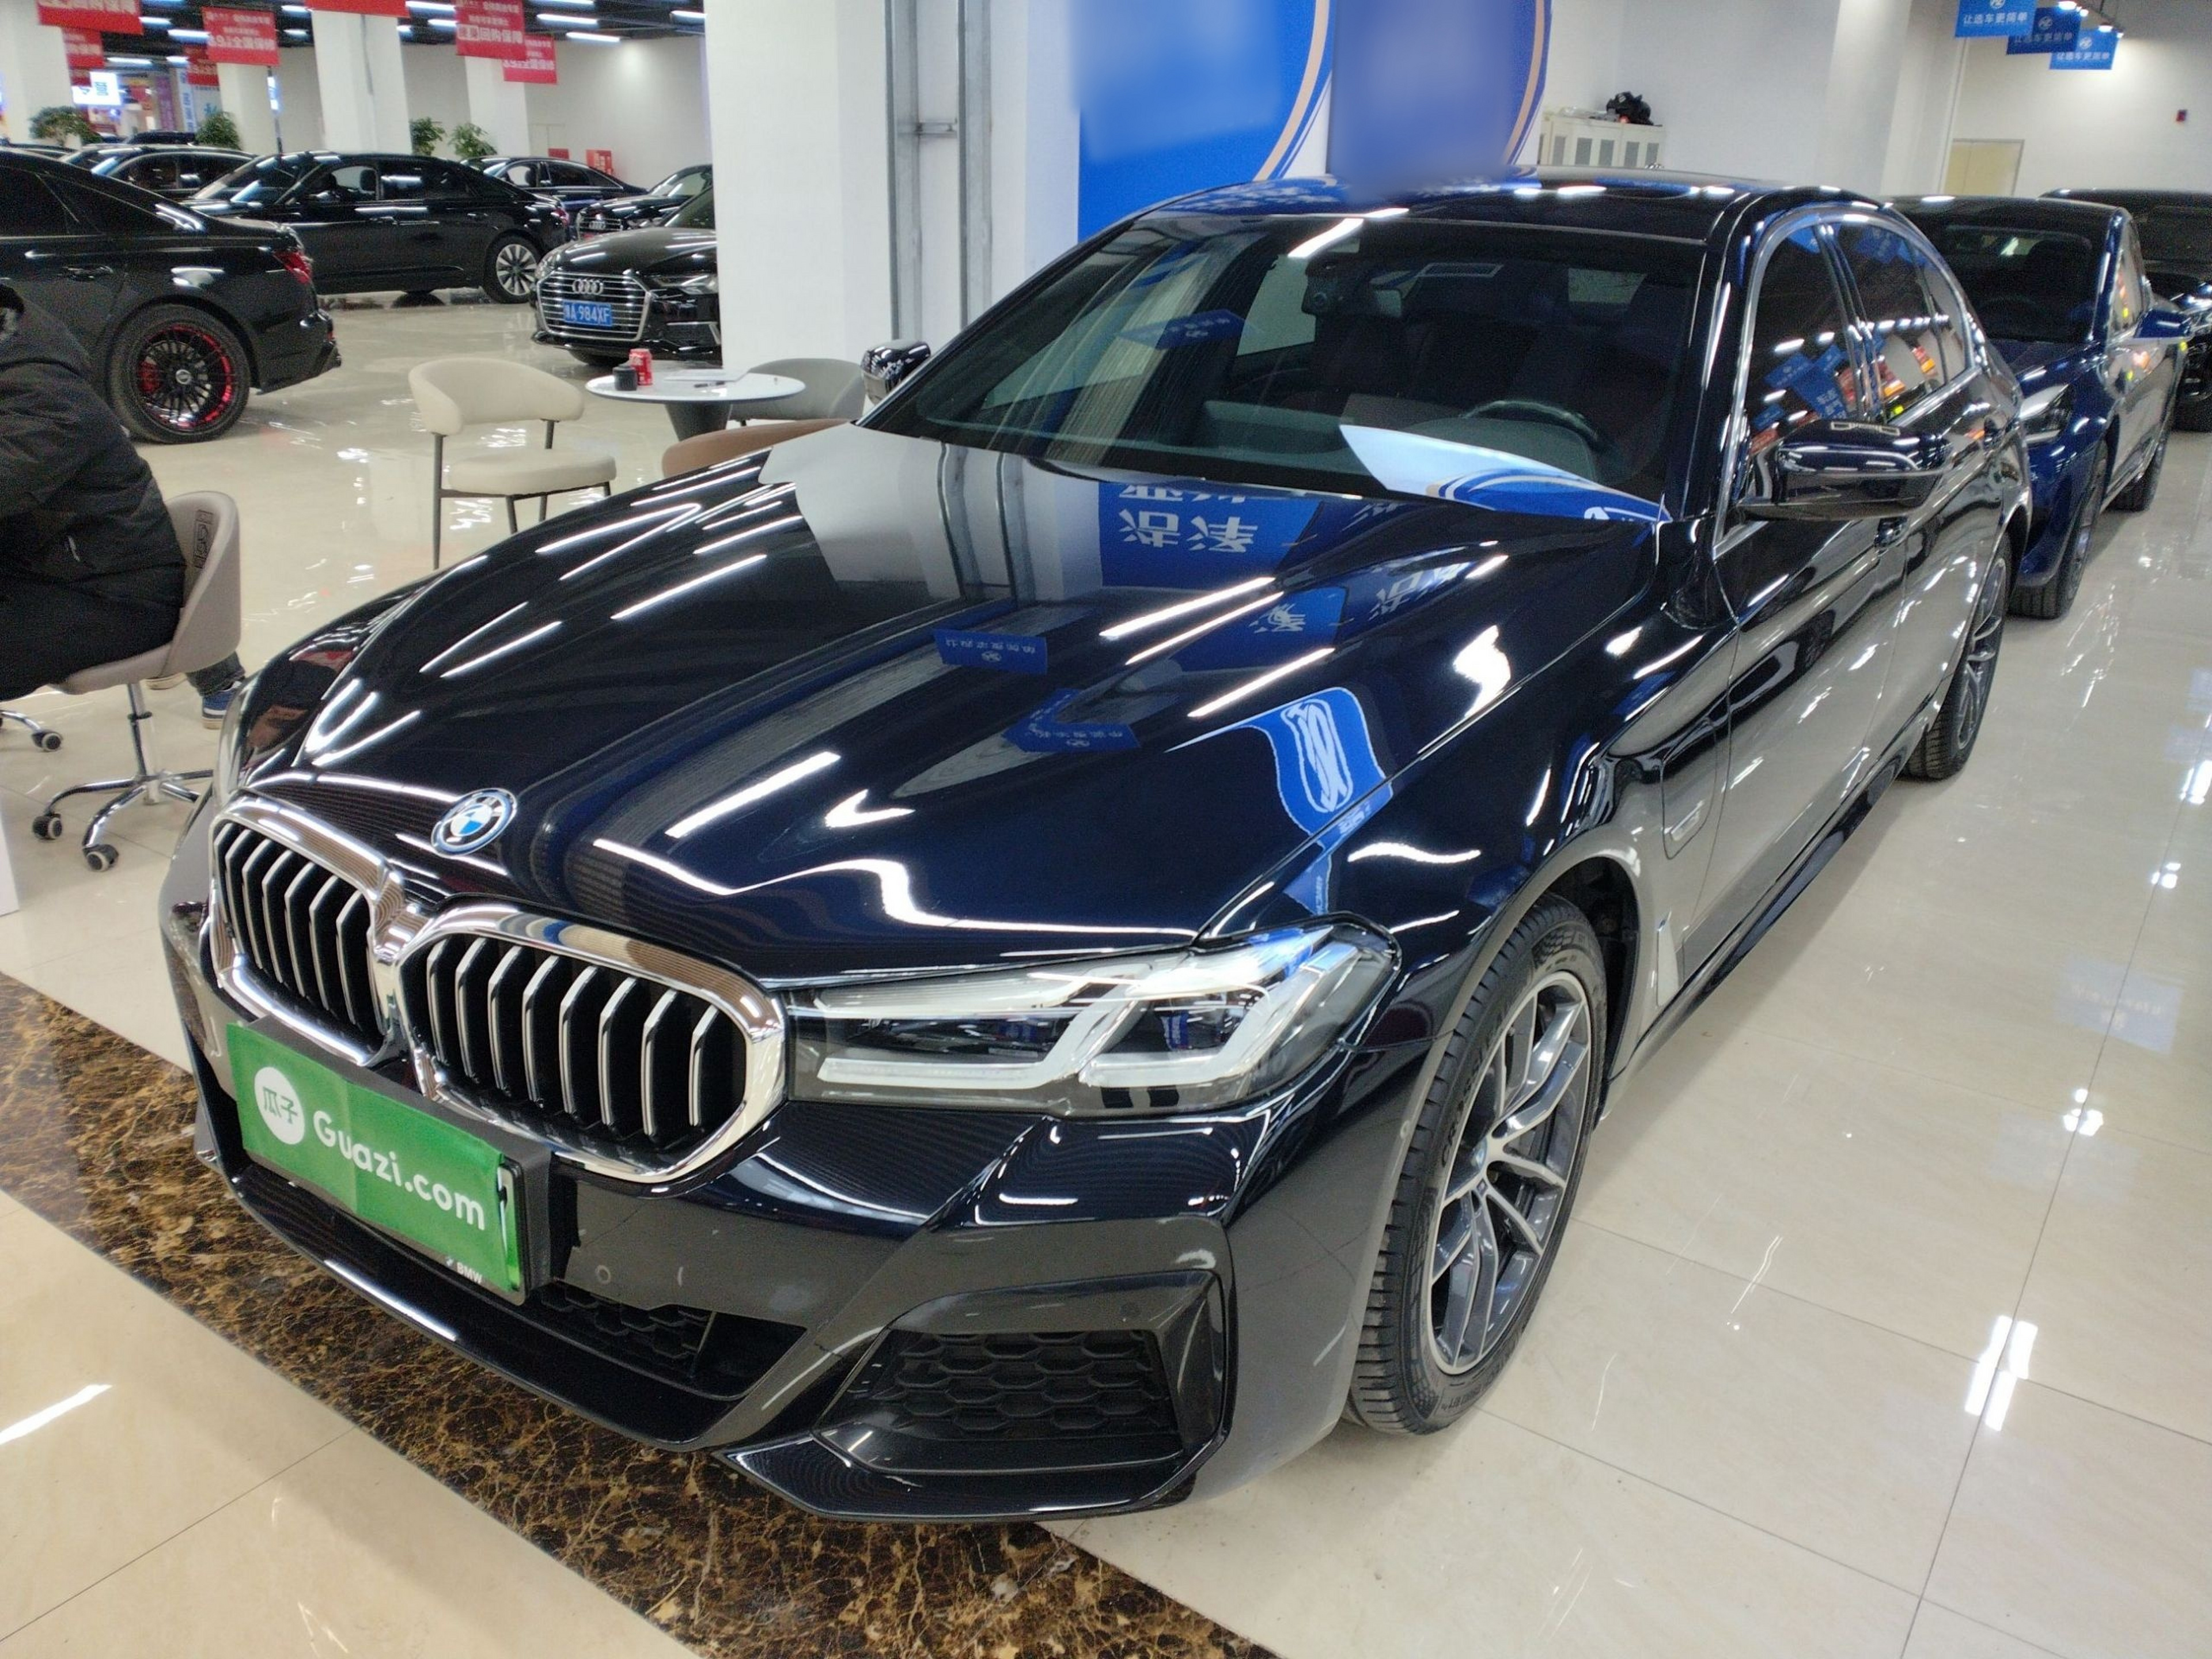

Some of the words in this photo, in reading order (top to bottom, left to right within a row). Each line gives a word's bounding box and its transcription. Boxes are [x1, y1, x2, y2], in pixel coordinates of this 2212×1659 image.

[1963, 12, 2028, 25] 让选车更简单
[263, 1086, 298, 1124] 瓜子
[313, 1110, 485, 1231] Guazi.com
[457, 1262, 482, 1285] BMW
